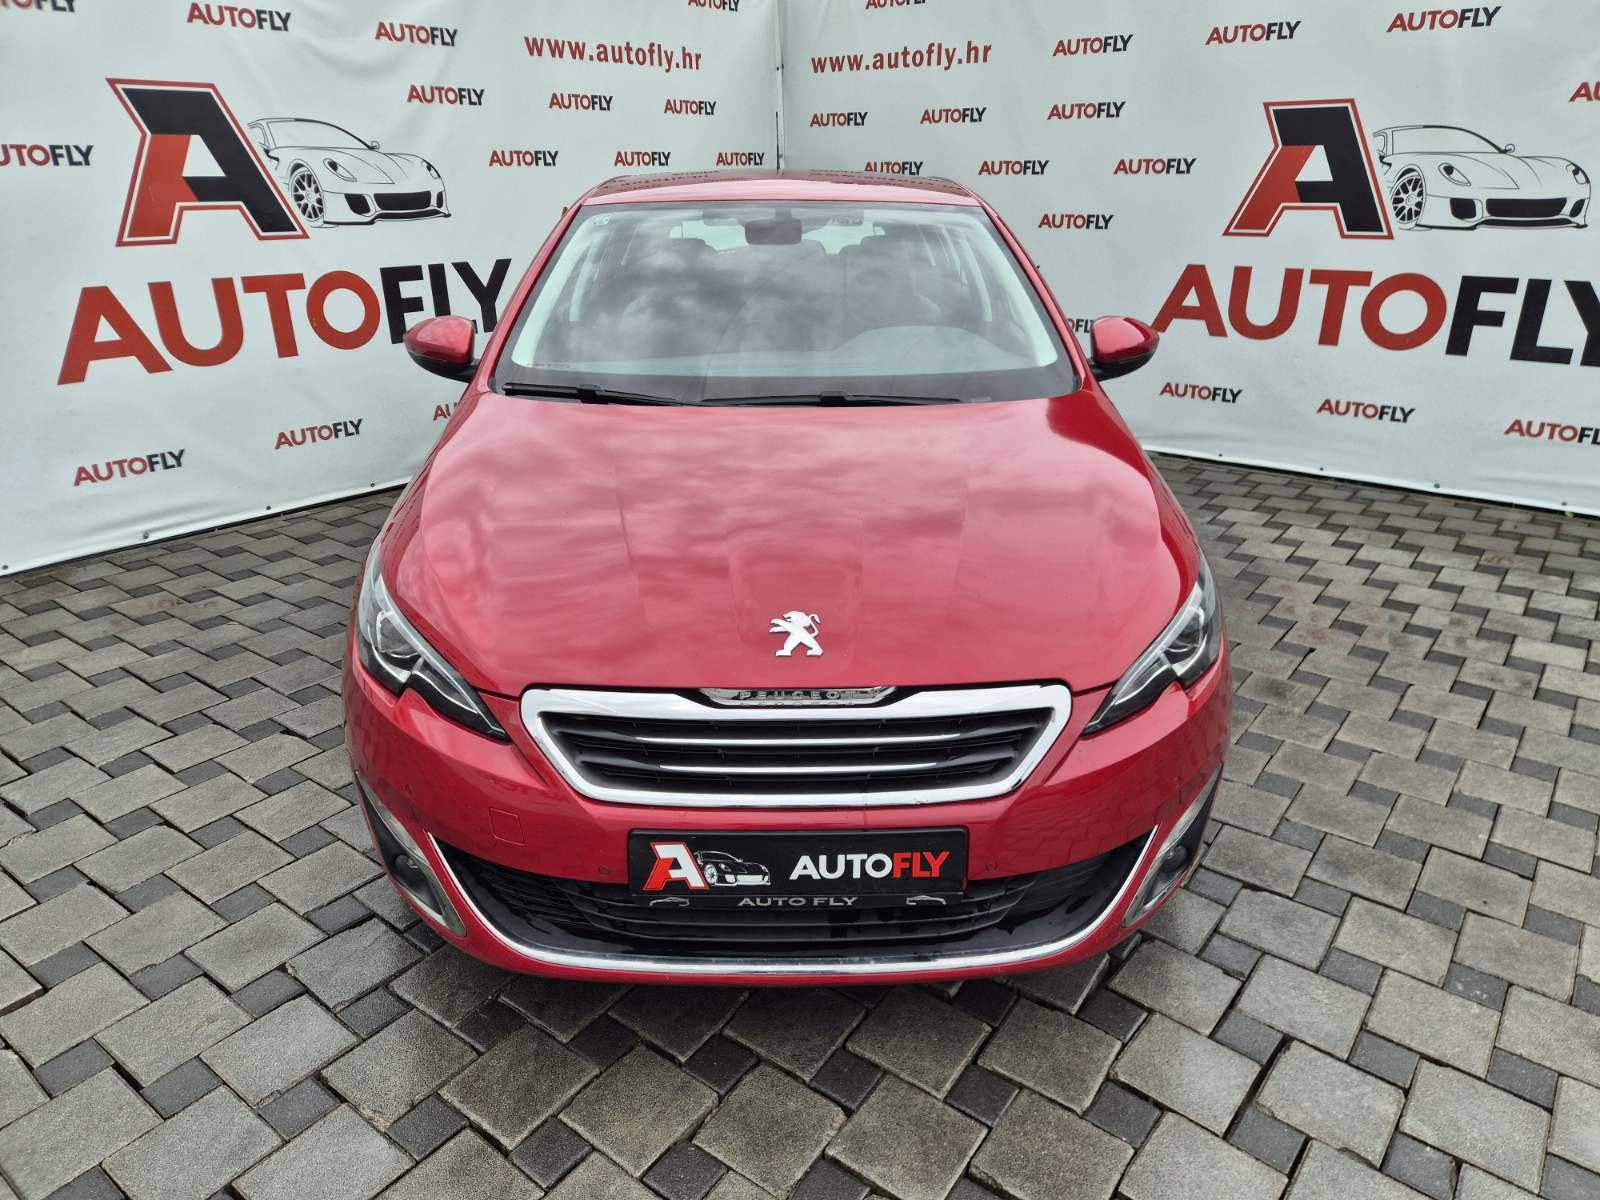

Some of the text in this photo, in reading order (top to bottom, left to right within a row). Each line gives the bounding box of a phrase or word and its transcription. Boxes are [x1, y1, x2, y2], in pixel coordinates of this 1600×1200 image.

[187, 2, 291, 32] AUTOFLY
[1386, 6, 1502, 32] AUTOFLY
[375, 22, 458, 47] AUTOFLY
[1205, 21, 1301, 45] AUTOFLY
[524, 36, 702, 73] www.autofly.hr
[1053, 34, 1133, 56] AUTOFLY
[811, 41, 992, 73] www.autofly.hr
[407, 85, 484, 106] AUTOFLY
[549, 93, 613, 111] AUTOFLY
[664, 98, 716, 116] AUTOFLY
[920, 107, 987, 124] AUTOFLY
[1047, 101, 1126, 120] AUTOFLY
[810, 112, 868, 128] AUTOFLY
[0, 144, 94, 167] UTOFLY
[489, 150, 559, 167] AUTOFLY
[614, 151, 671, 167] AUTOFLY
[716, 152, 765, 167] AUTOFLY
[864, 161, 924, 176] AUTOFLY
[978, 160, 1049, 176] AUTOFLY
[1114, 158, 1197, 175] AUTOFLY
[1038, 214, 1114, 230] AUTOFLY
[1160, 382, 1242, 404] AUTOFLY
[1317, 399, 1416, 424] AUTOFLY
[275, 418, 364, 450] AUTOFLY
[1504, 419, 1600, 446] AUTOFL
[74, 449, 185, 487] AUTOFLY
[738, 690, 857, 701] PEUGEO
[790, 852, 949, 880] AUTOFLY
[738, 897, 858, 906] AUTO FLY
